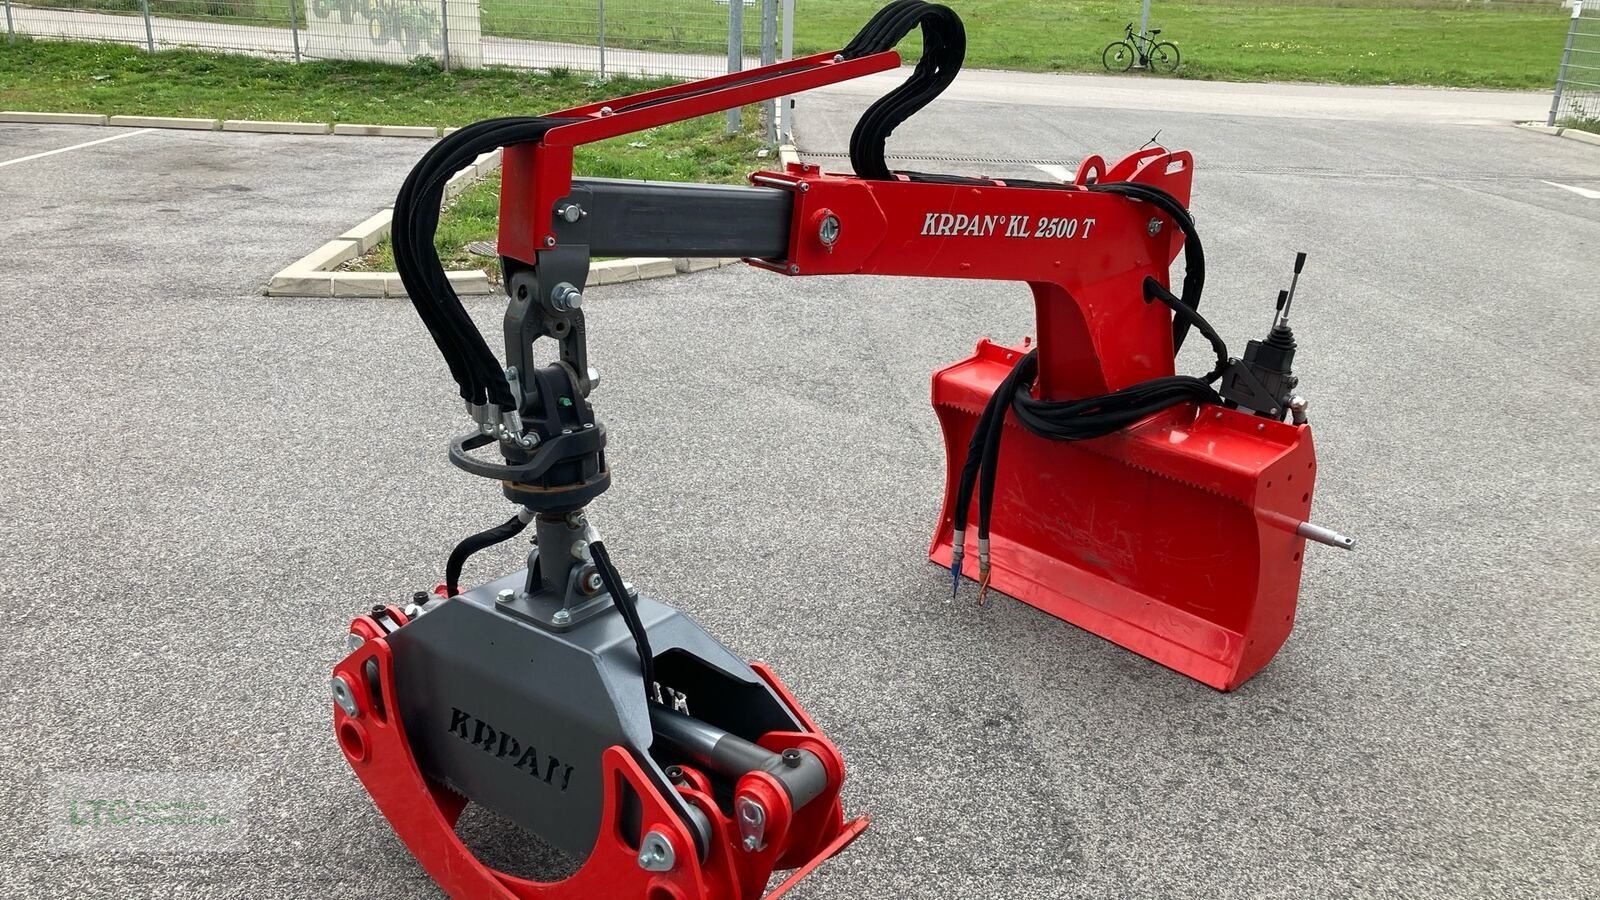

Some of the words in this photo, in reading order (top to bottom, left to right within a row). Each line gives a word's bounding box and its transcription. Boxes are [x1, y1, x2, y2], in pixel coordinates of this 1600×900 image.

[1005, 215, 1031, 238] KL
[1034, 217, 1078, 239] 2500
[1082, 218, 1096, 239] T
[448, 706, 575, 793] KRPAN
